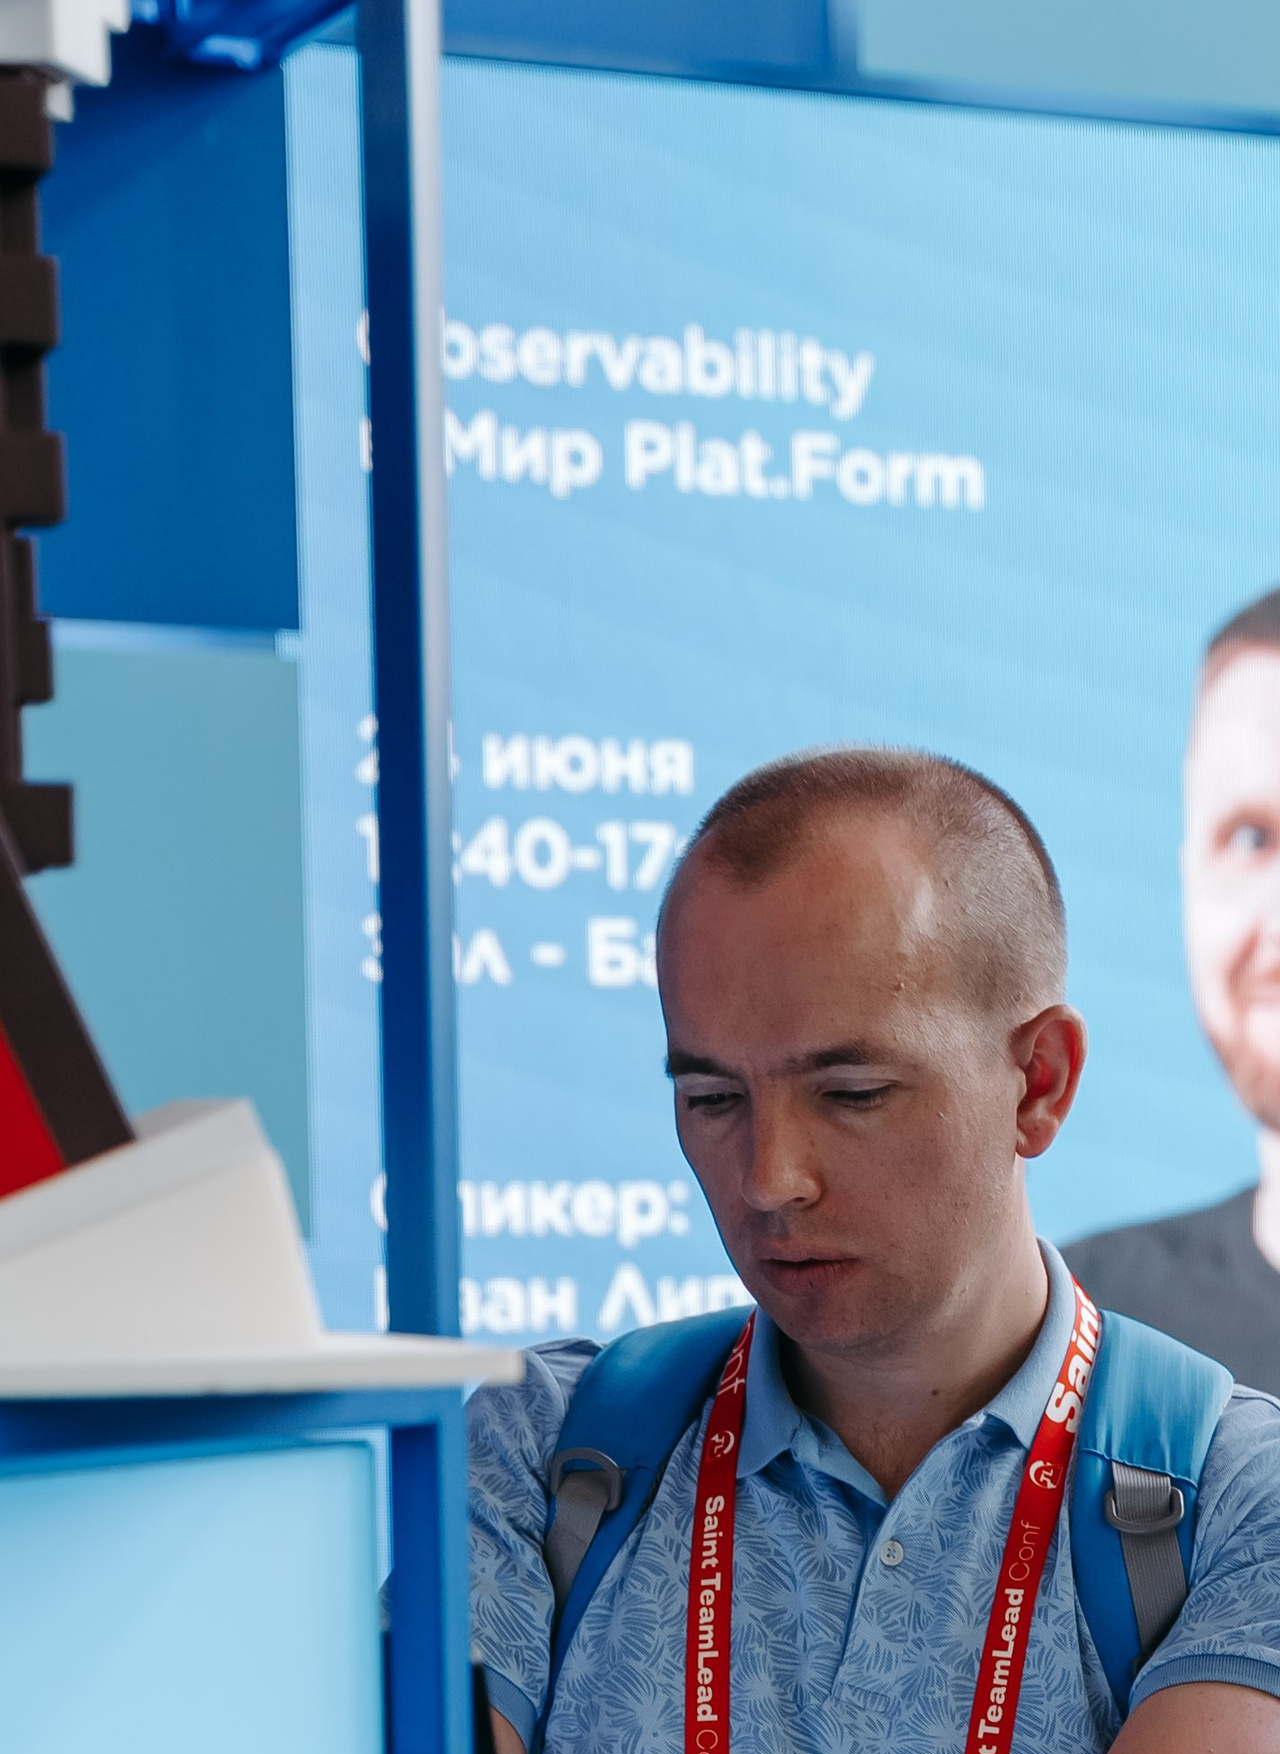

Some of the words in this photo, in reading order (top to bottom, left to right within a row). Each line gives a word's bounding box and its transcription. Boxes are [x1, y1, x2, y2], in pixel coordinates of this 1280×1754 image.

[356, 308, 874, 420] bservability
[442, 408, 602, 500] Мир
[624, 418, 986, 512] Plat.Form
[480, 732, 695, 796] июня
[374, 1262, 579, 1334] ан
[701, 1495, 725, 1569] Saint
[696, 1573, 721, 1722] TeamLead
[978, 1588, 1025, 1736] TeamLead
[1009, 1519, 1041, 1582] Conf
